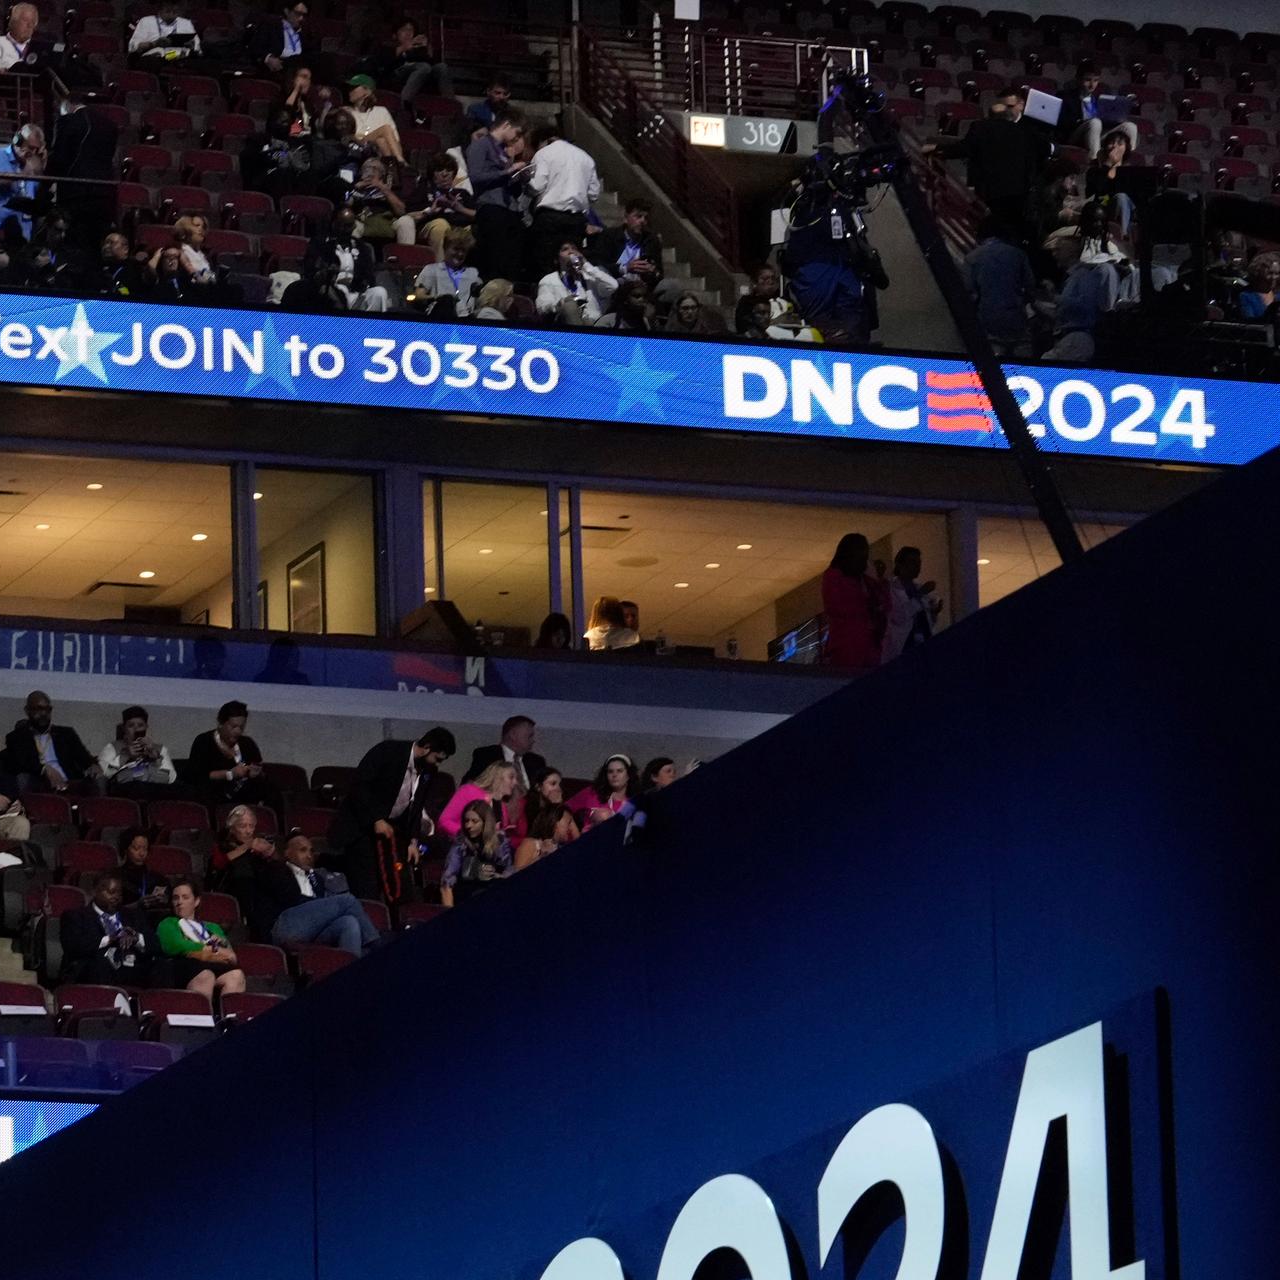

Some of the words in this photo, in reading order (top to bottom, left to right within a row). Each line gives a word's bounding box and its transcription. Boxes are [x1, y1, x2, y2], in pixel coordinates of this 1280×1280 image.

[742, 121, 781, 146] 318
[111, 322, 264, 375] JOIN
[284, 335, 345, 379] to
[363, 338, 560, 394] 30330
[722, 354, 920, 430] DNC
